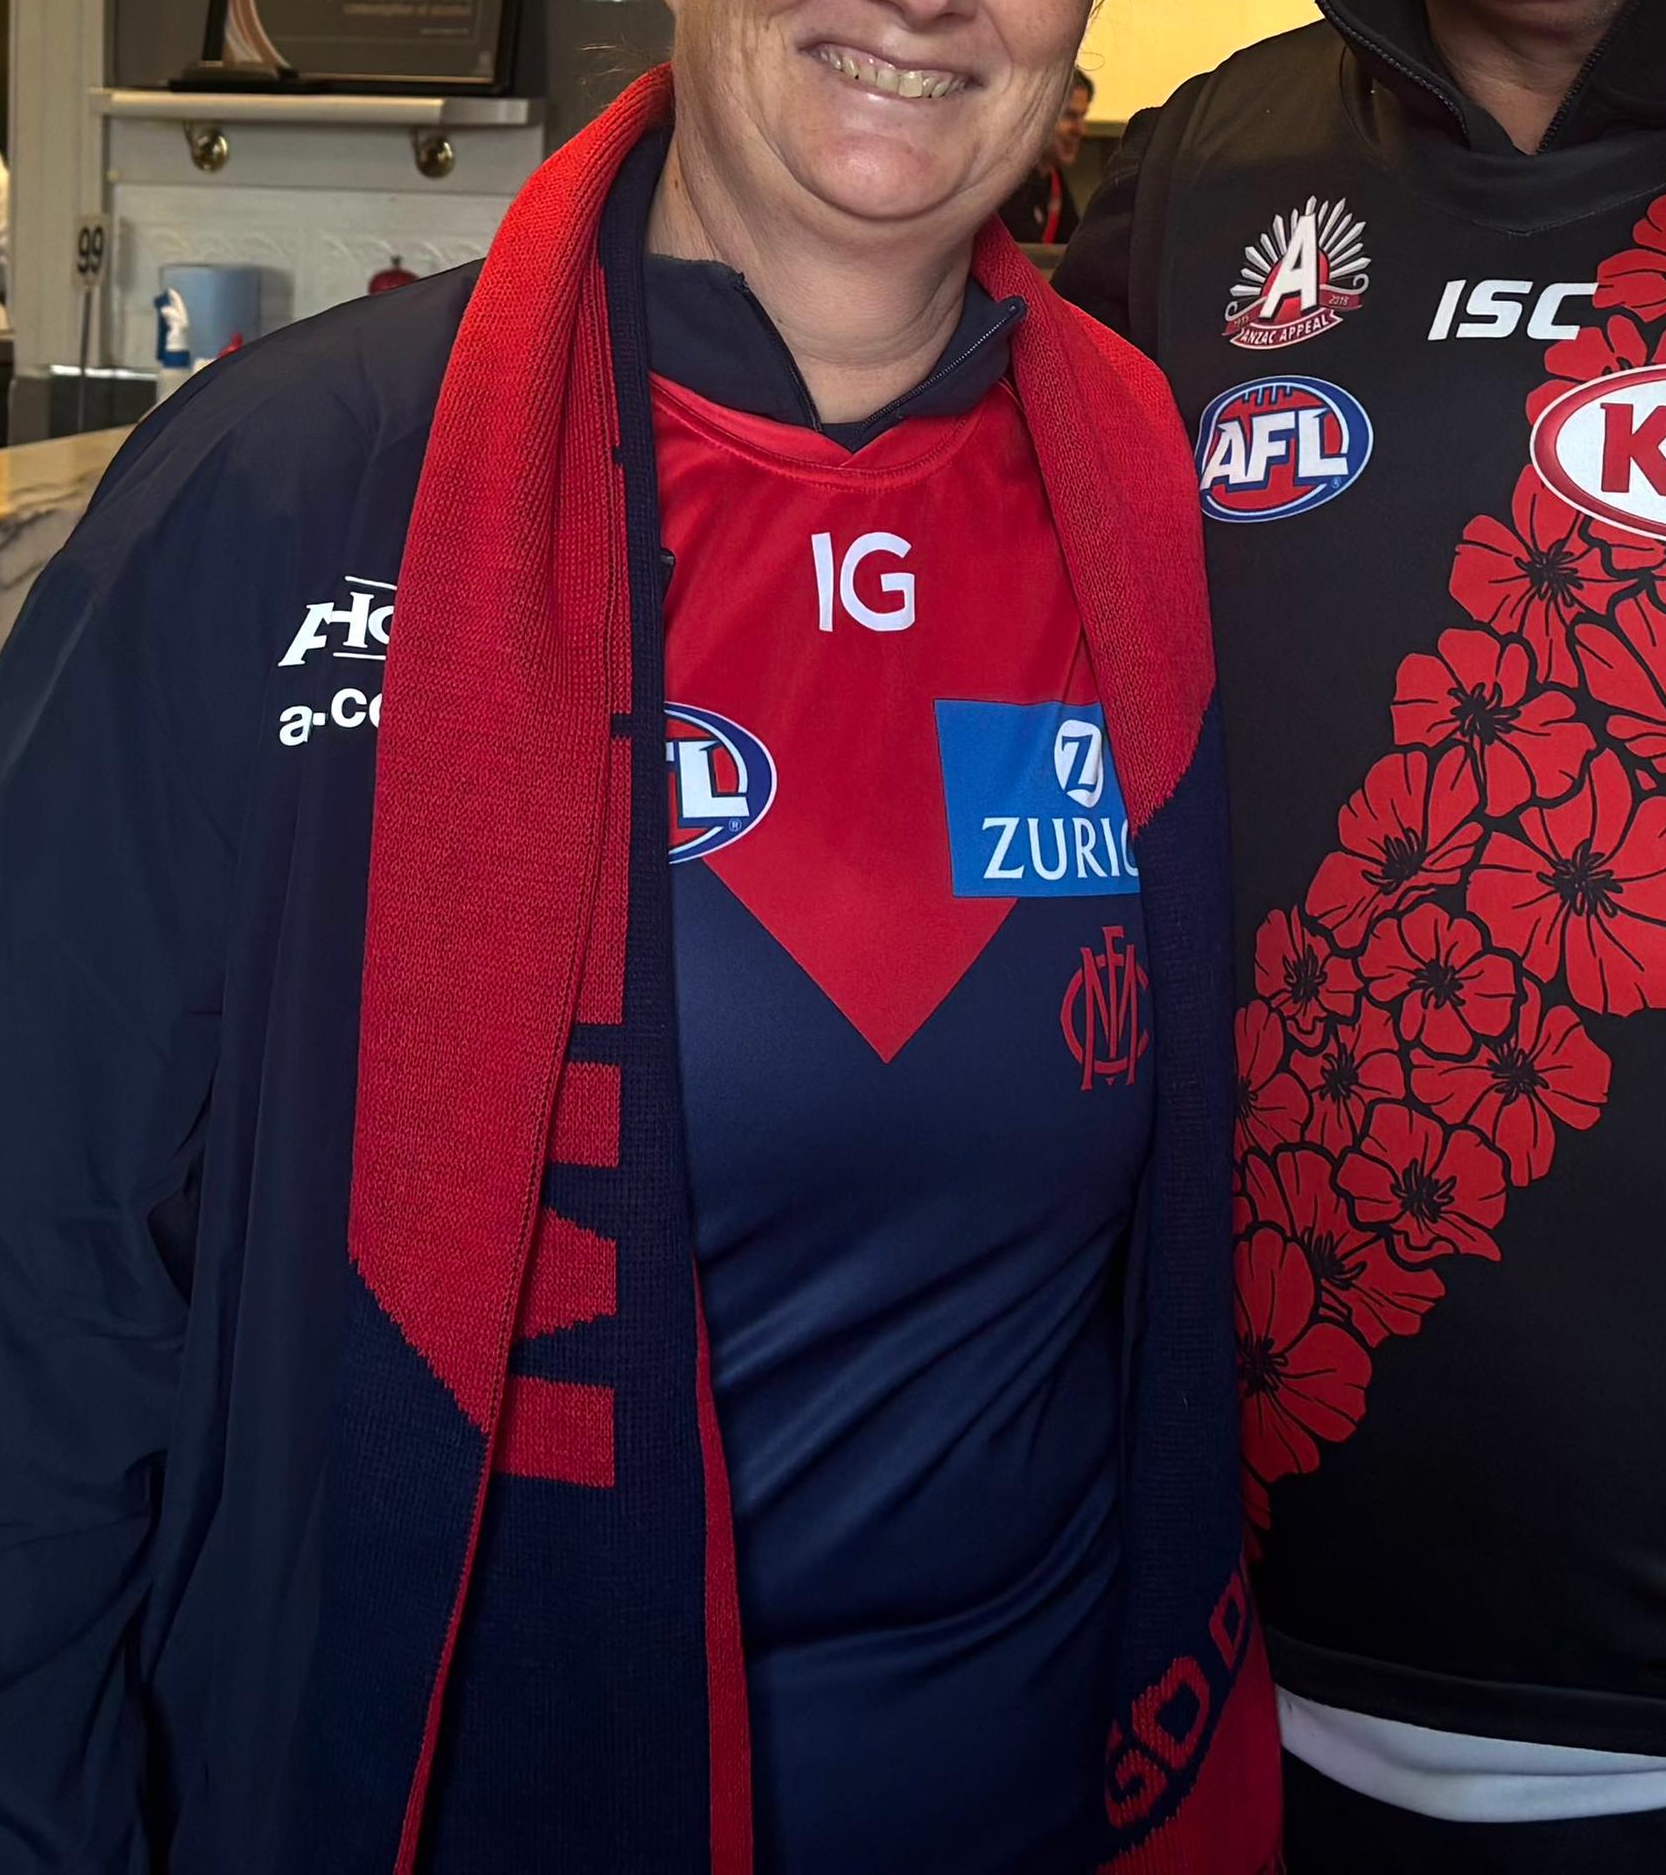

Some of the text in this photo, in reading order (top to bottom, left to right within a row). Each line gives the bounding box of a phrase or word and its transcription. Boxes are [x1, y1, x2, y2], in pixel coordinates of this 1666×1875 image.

[77, 226, 103, 274] 99
[1240, 315, 1330, 345] ANZAC APPEAL
[1428, 279, 1599, 341] ISC
[1199, 407, 1350, 490] AFL
[810, 530, 917, 633] IG
